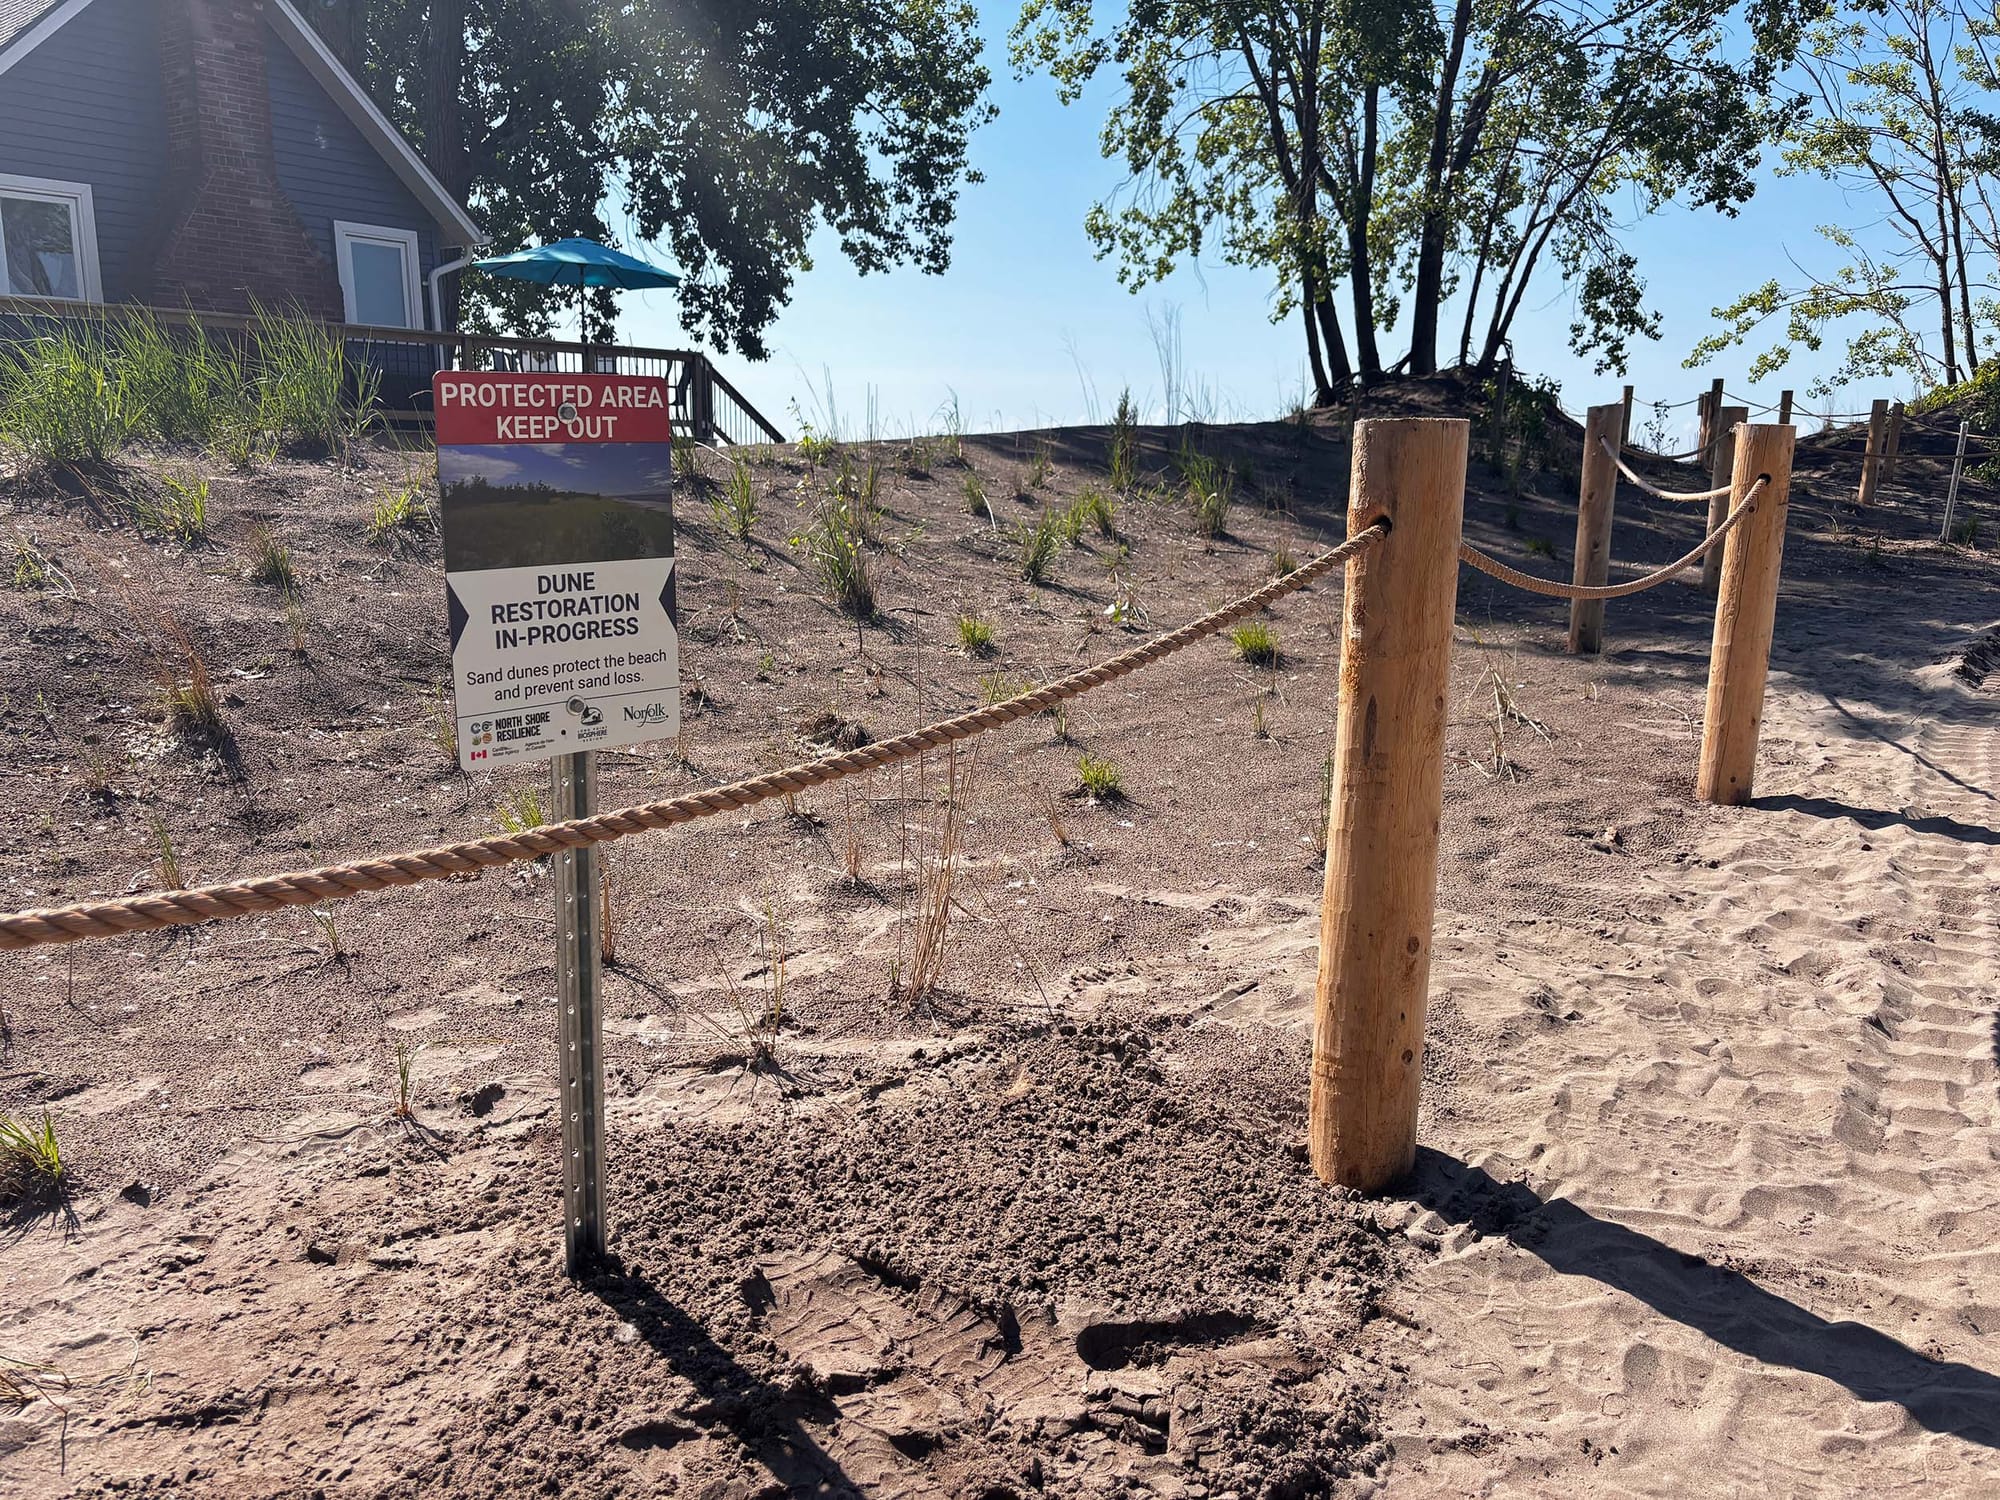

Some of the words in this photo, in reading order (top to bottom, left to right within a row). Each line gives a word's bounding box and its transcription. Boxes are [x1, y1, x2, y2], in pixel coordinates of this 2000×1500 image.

[440, 382, 593, 408] PROTECTED
[600, 385, 664, 409] AREA
[496, 415, 560, 440] KEEP
[567, 415, 618, 439] OUT
[537, 571, 596, 595] DUNE
[490, 592, 640, 625] RESTORATION
[495, 616, 640, 650] IN-PROGRESS
[466, 667, 503, 686] Sand
[507, 664, 549, 681] dunes
[552, 656, 601, 682] protect
[603, 653, 625, 669] the
[628, 649, 667, 665] beach
[494, 685, 521, 701] and
[524, 678, 575, 700] prevent
[578, 671, 610, 690] sand
[613, 669, 645, 685] loss.
[495, 715, 523, 731] NORTH
[524, 711, 551, 725] SHORE
[623, 702, 666, 728] Norfolk
[496, 724, 542, 742] RESILIENCE
